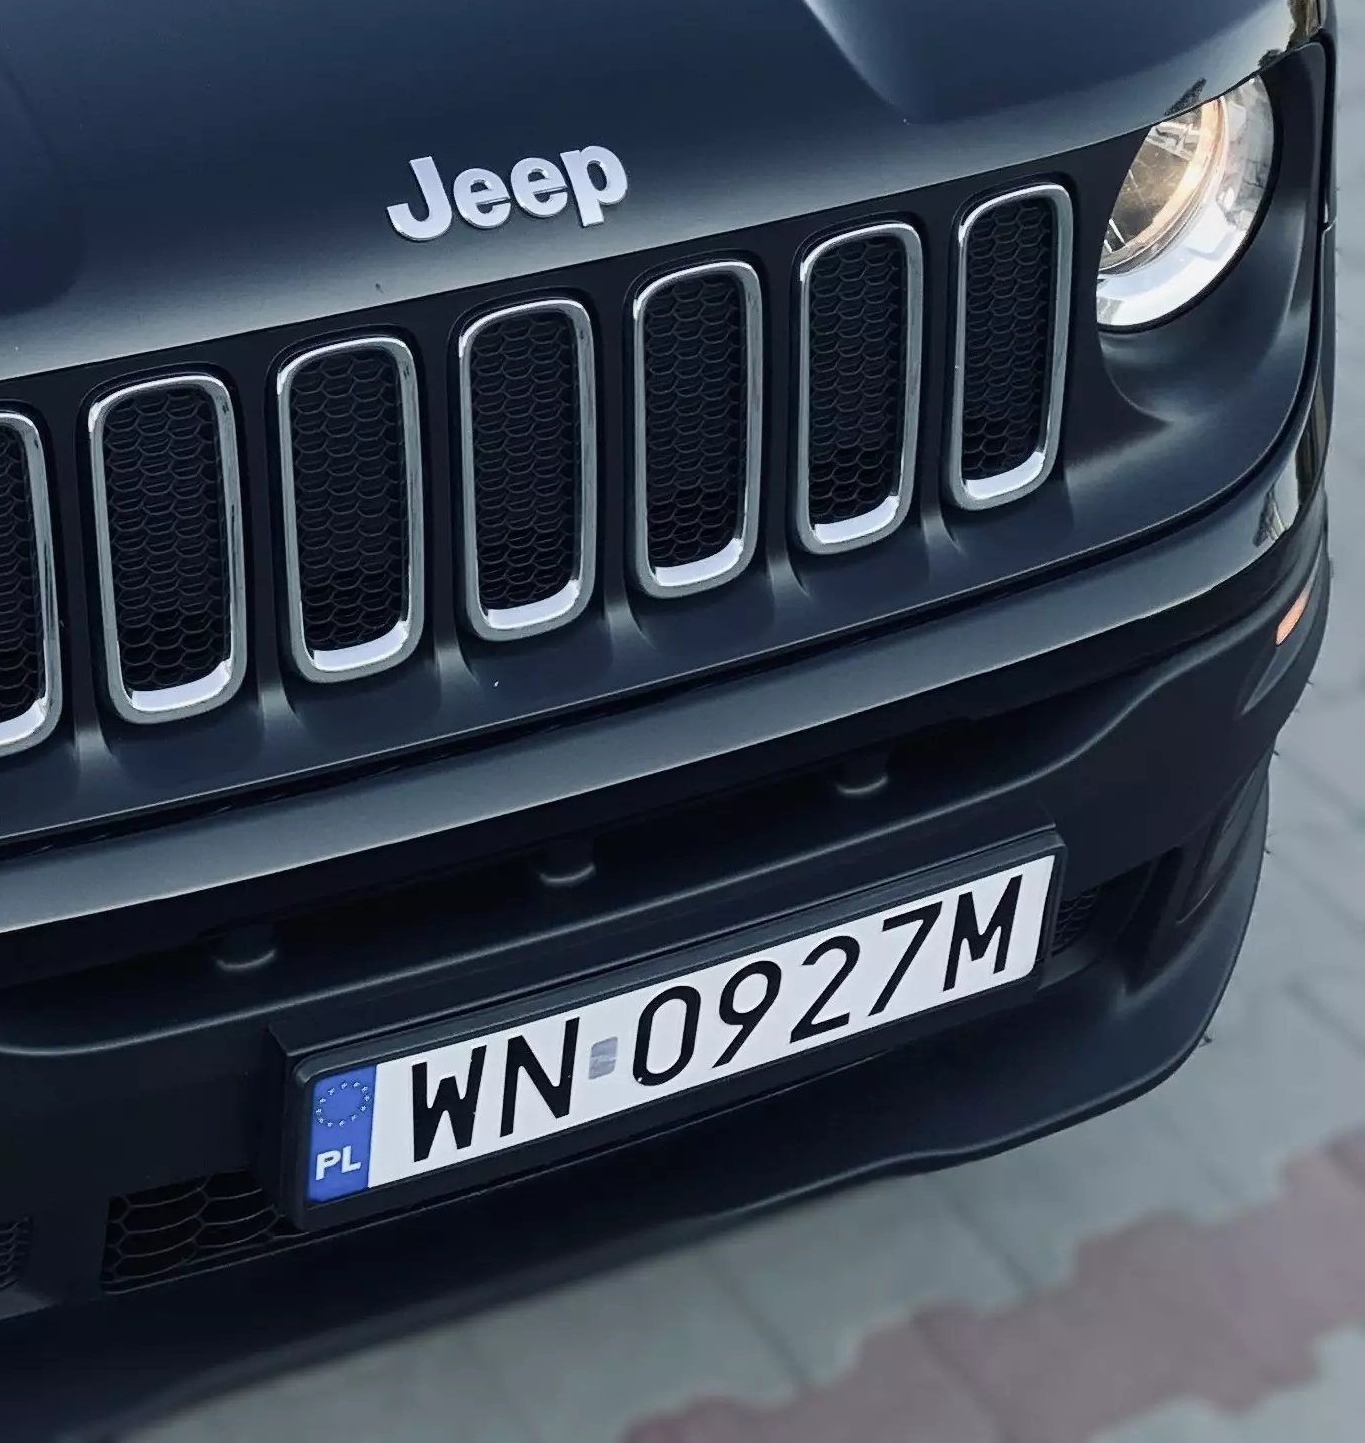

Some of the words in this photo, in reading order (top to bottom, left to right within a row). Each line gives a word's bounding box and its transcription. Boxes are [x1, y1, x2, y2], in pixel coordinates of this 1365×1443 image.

[386, 145, 628, 242] Jeep
[411, 1017, 581, 1163] WN
[635, 874, 1024, 1087] 0927M
[314, 1146, 362, 1181] PL
